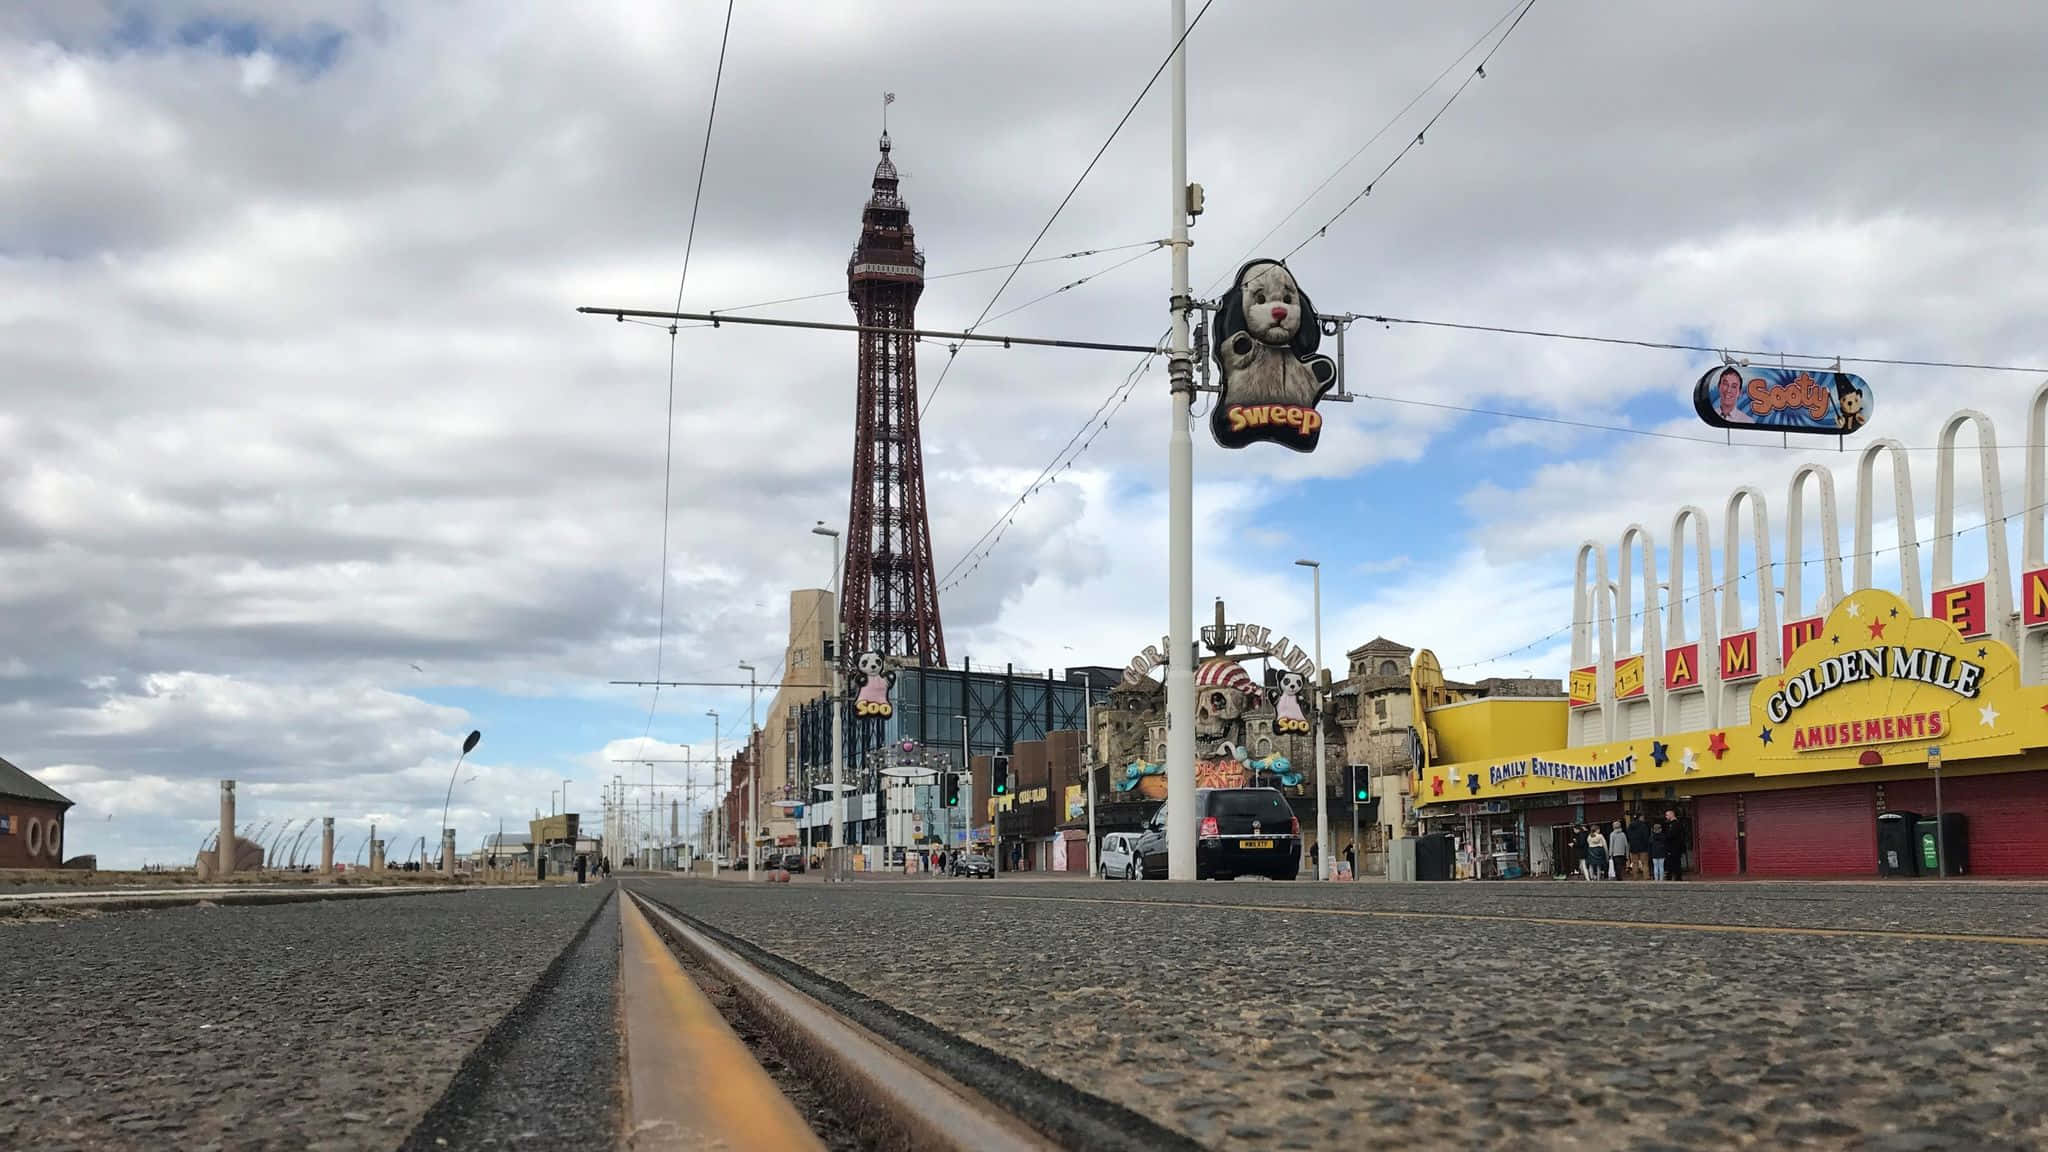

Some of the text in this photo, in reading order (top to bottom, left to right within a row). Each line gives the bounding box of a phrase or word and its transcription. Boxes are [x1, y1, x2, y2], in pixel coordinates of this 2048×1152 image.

[1747, 372, 1830, 420] Sooty
[1228, 405, 1322, 435] Sweep
[1766, 646, 1984, 725] GOLDEN MILE
[1278, 718, 1310, 734] SOO
[1793, 711, 1942, 750] AMUSEMENTS
[1489, 755, 1634, 785] FAMILY ENTERTAINMENT
